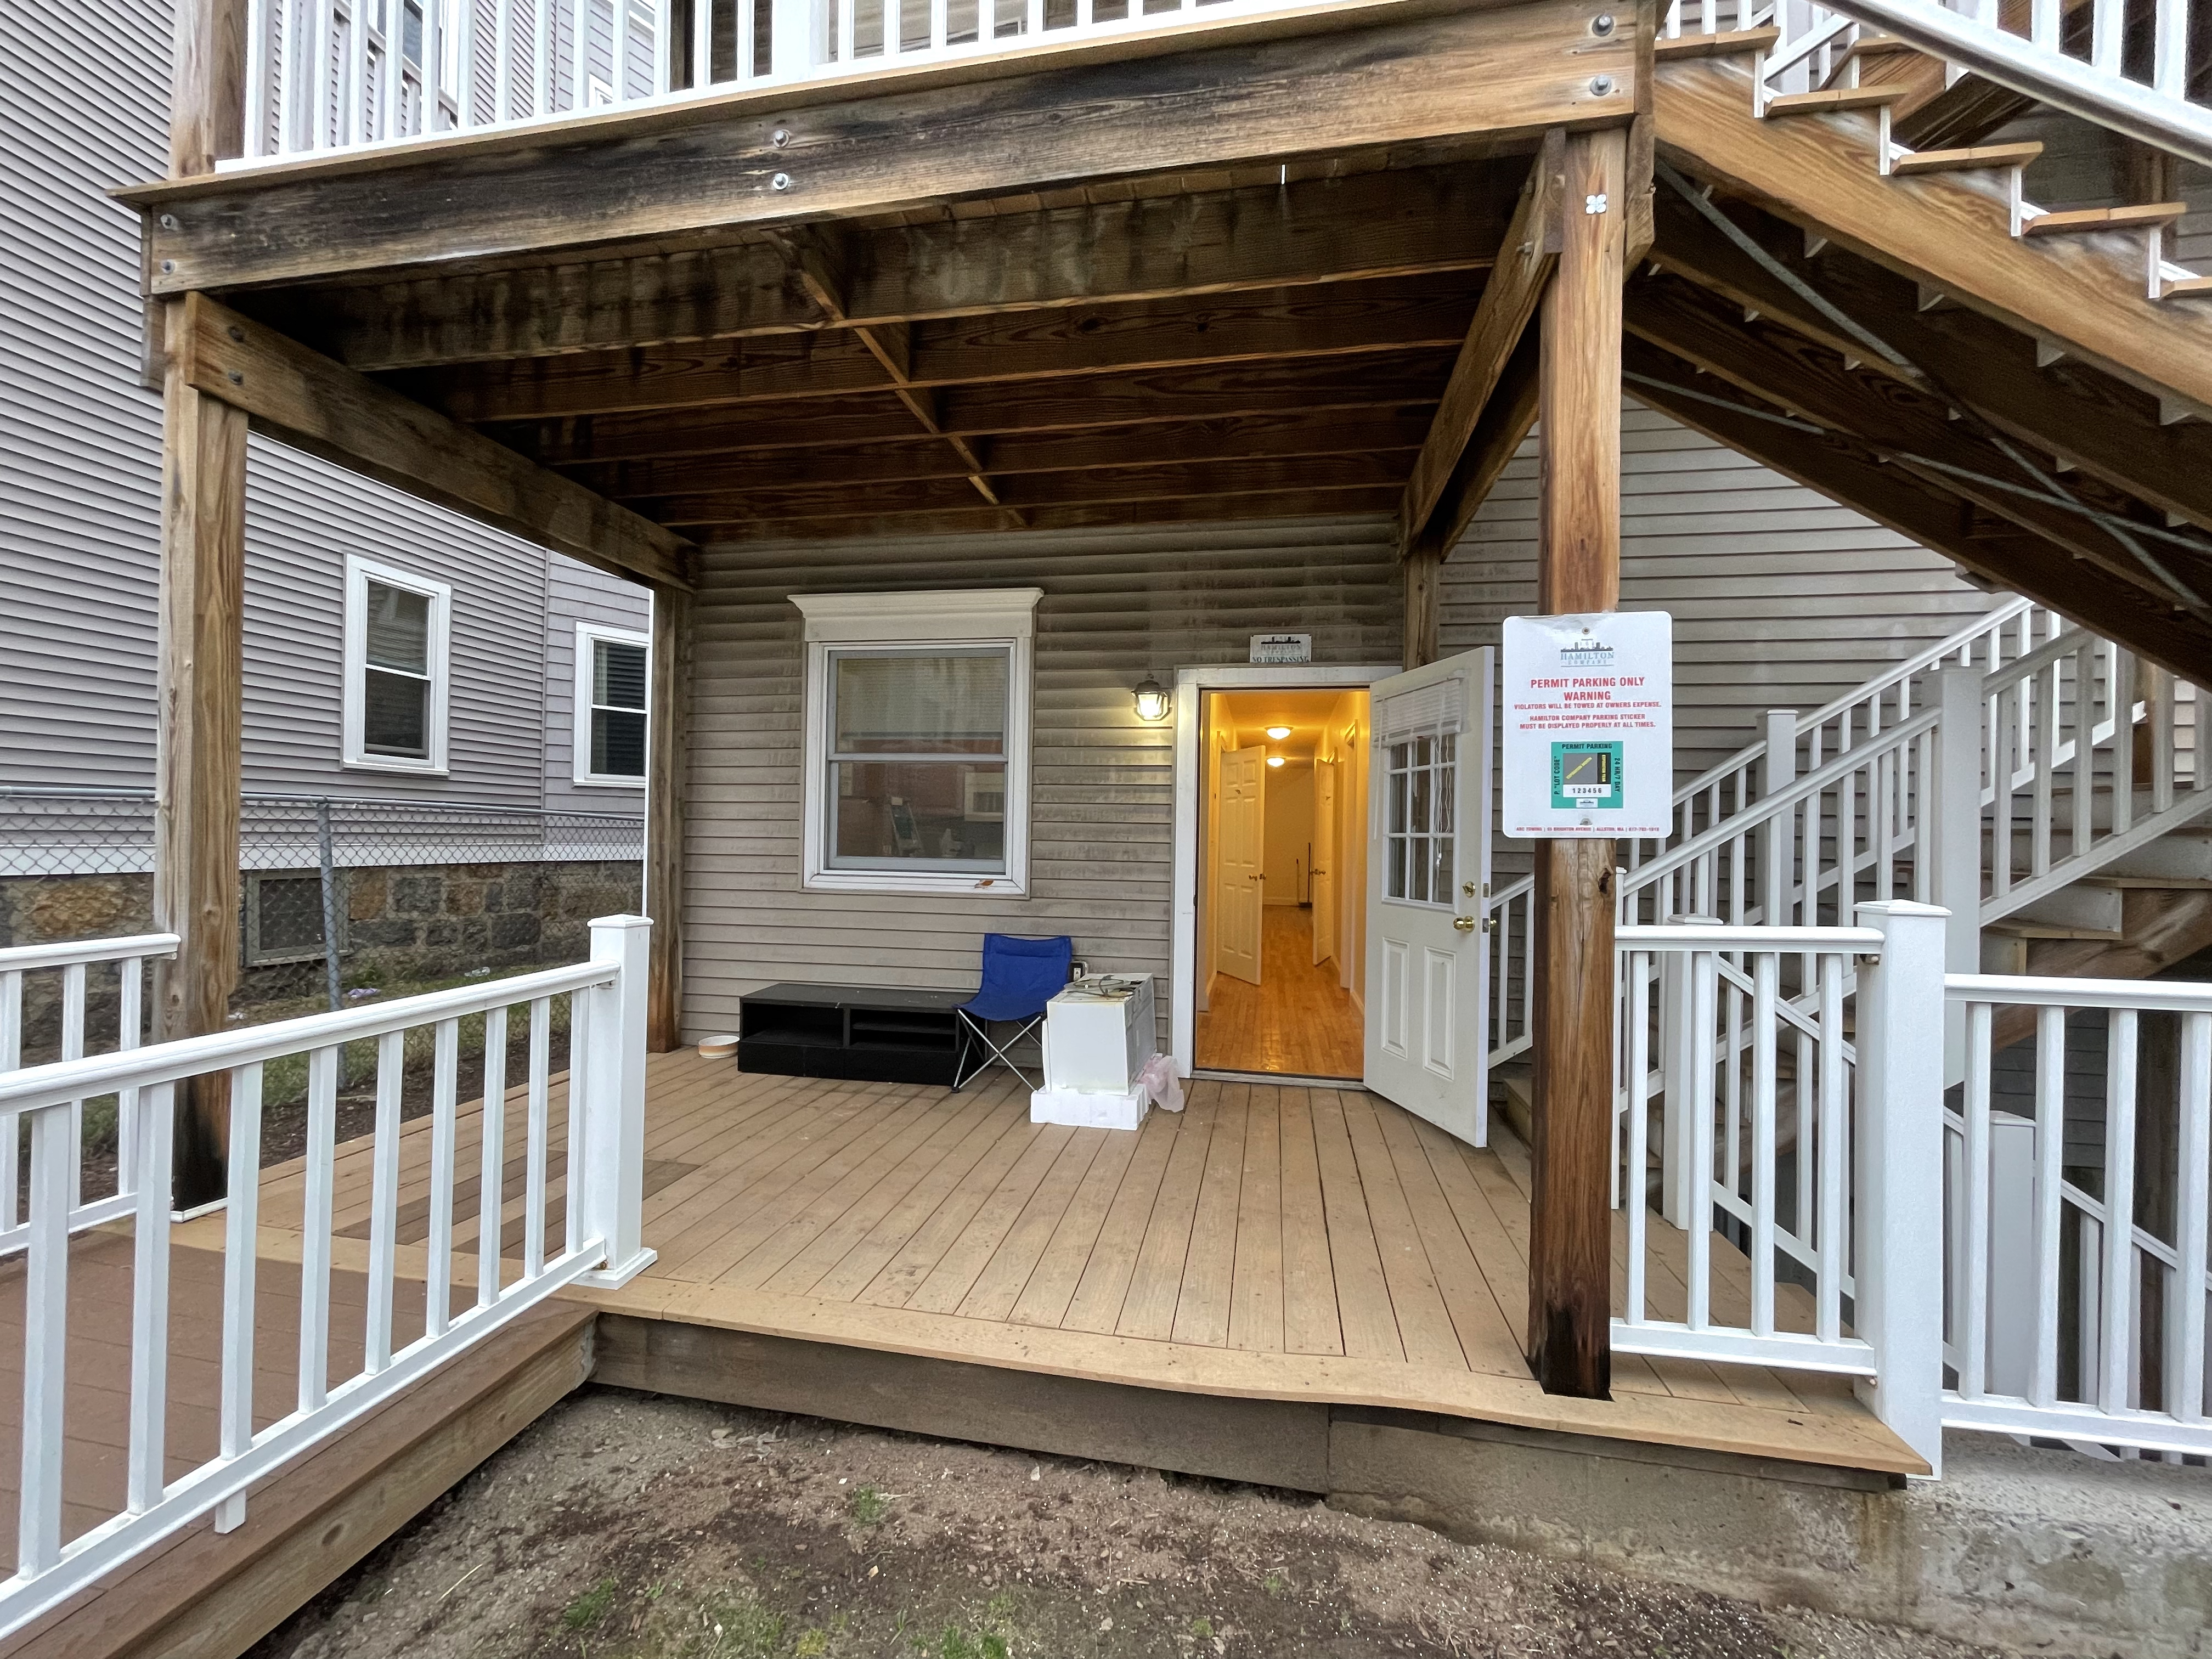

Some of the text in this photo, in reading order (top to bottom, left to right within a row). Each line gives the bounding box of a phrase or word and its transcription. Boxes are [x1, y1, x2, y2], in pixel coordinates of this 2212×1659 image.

[1560, 651, 1615, 660] HAMILTON
[1531, 677, 1645, 688] PERMIT PARKING ONLY
[1564, 691, 1611, 701] WARNING
